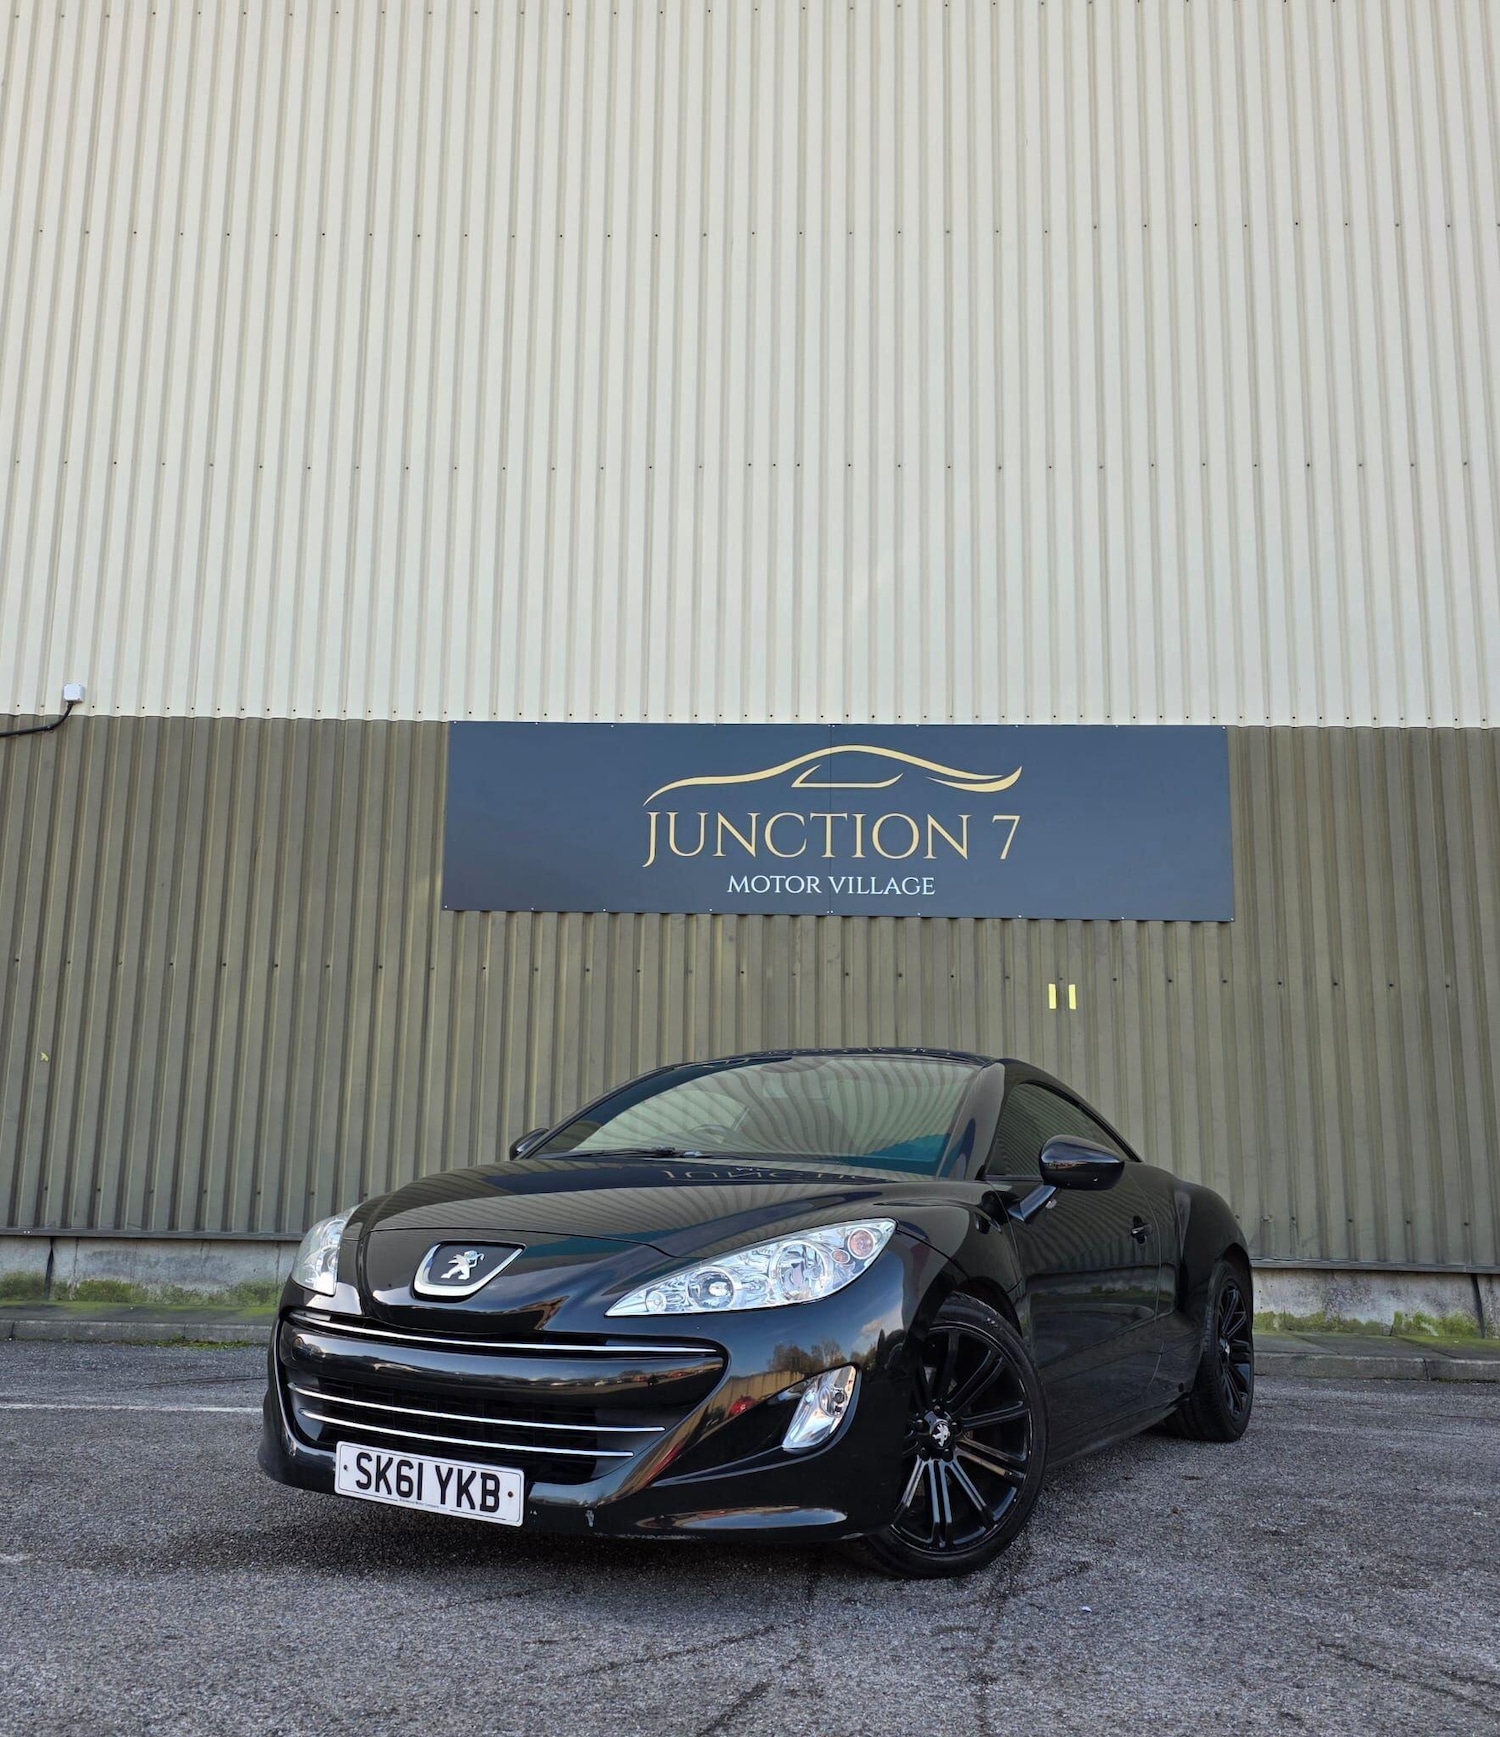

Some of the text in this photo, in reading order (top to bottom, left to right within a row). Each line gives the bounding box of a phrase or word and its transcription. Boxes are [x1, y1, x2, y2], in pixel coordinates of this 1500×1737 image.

[641, 811, 1021, 868] JUNCTION 7
[726, 874, 936, 896] MOTOR VILLAGE
[355, 1452, 500, 1513] SK61 YKB
